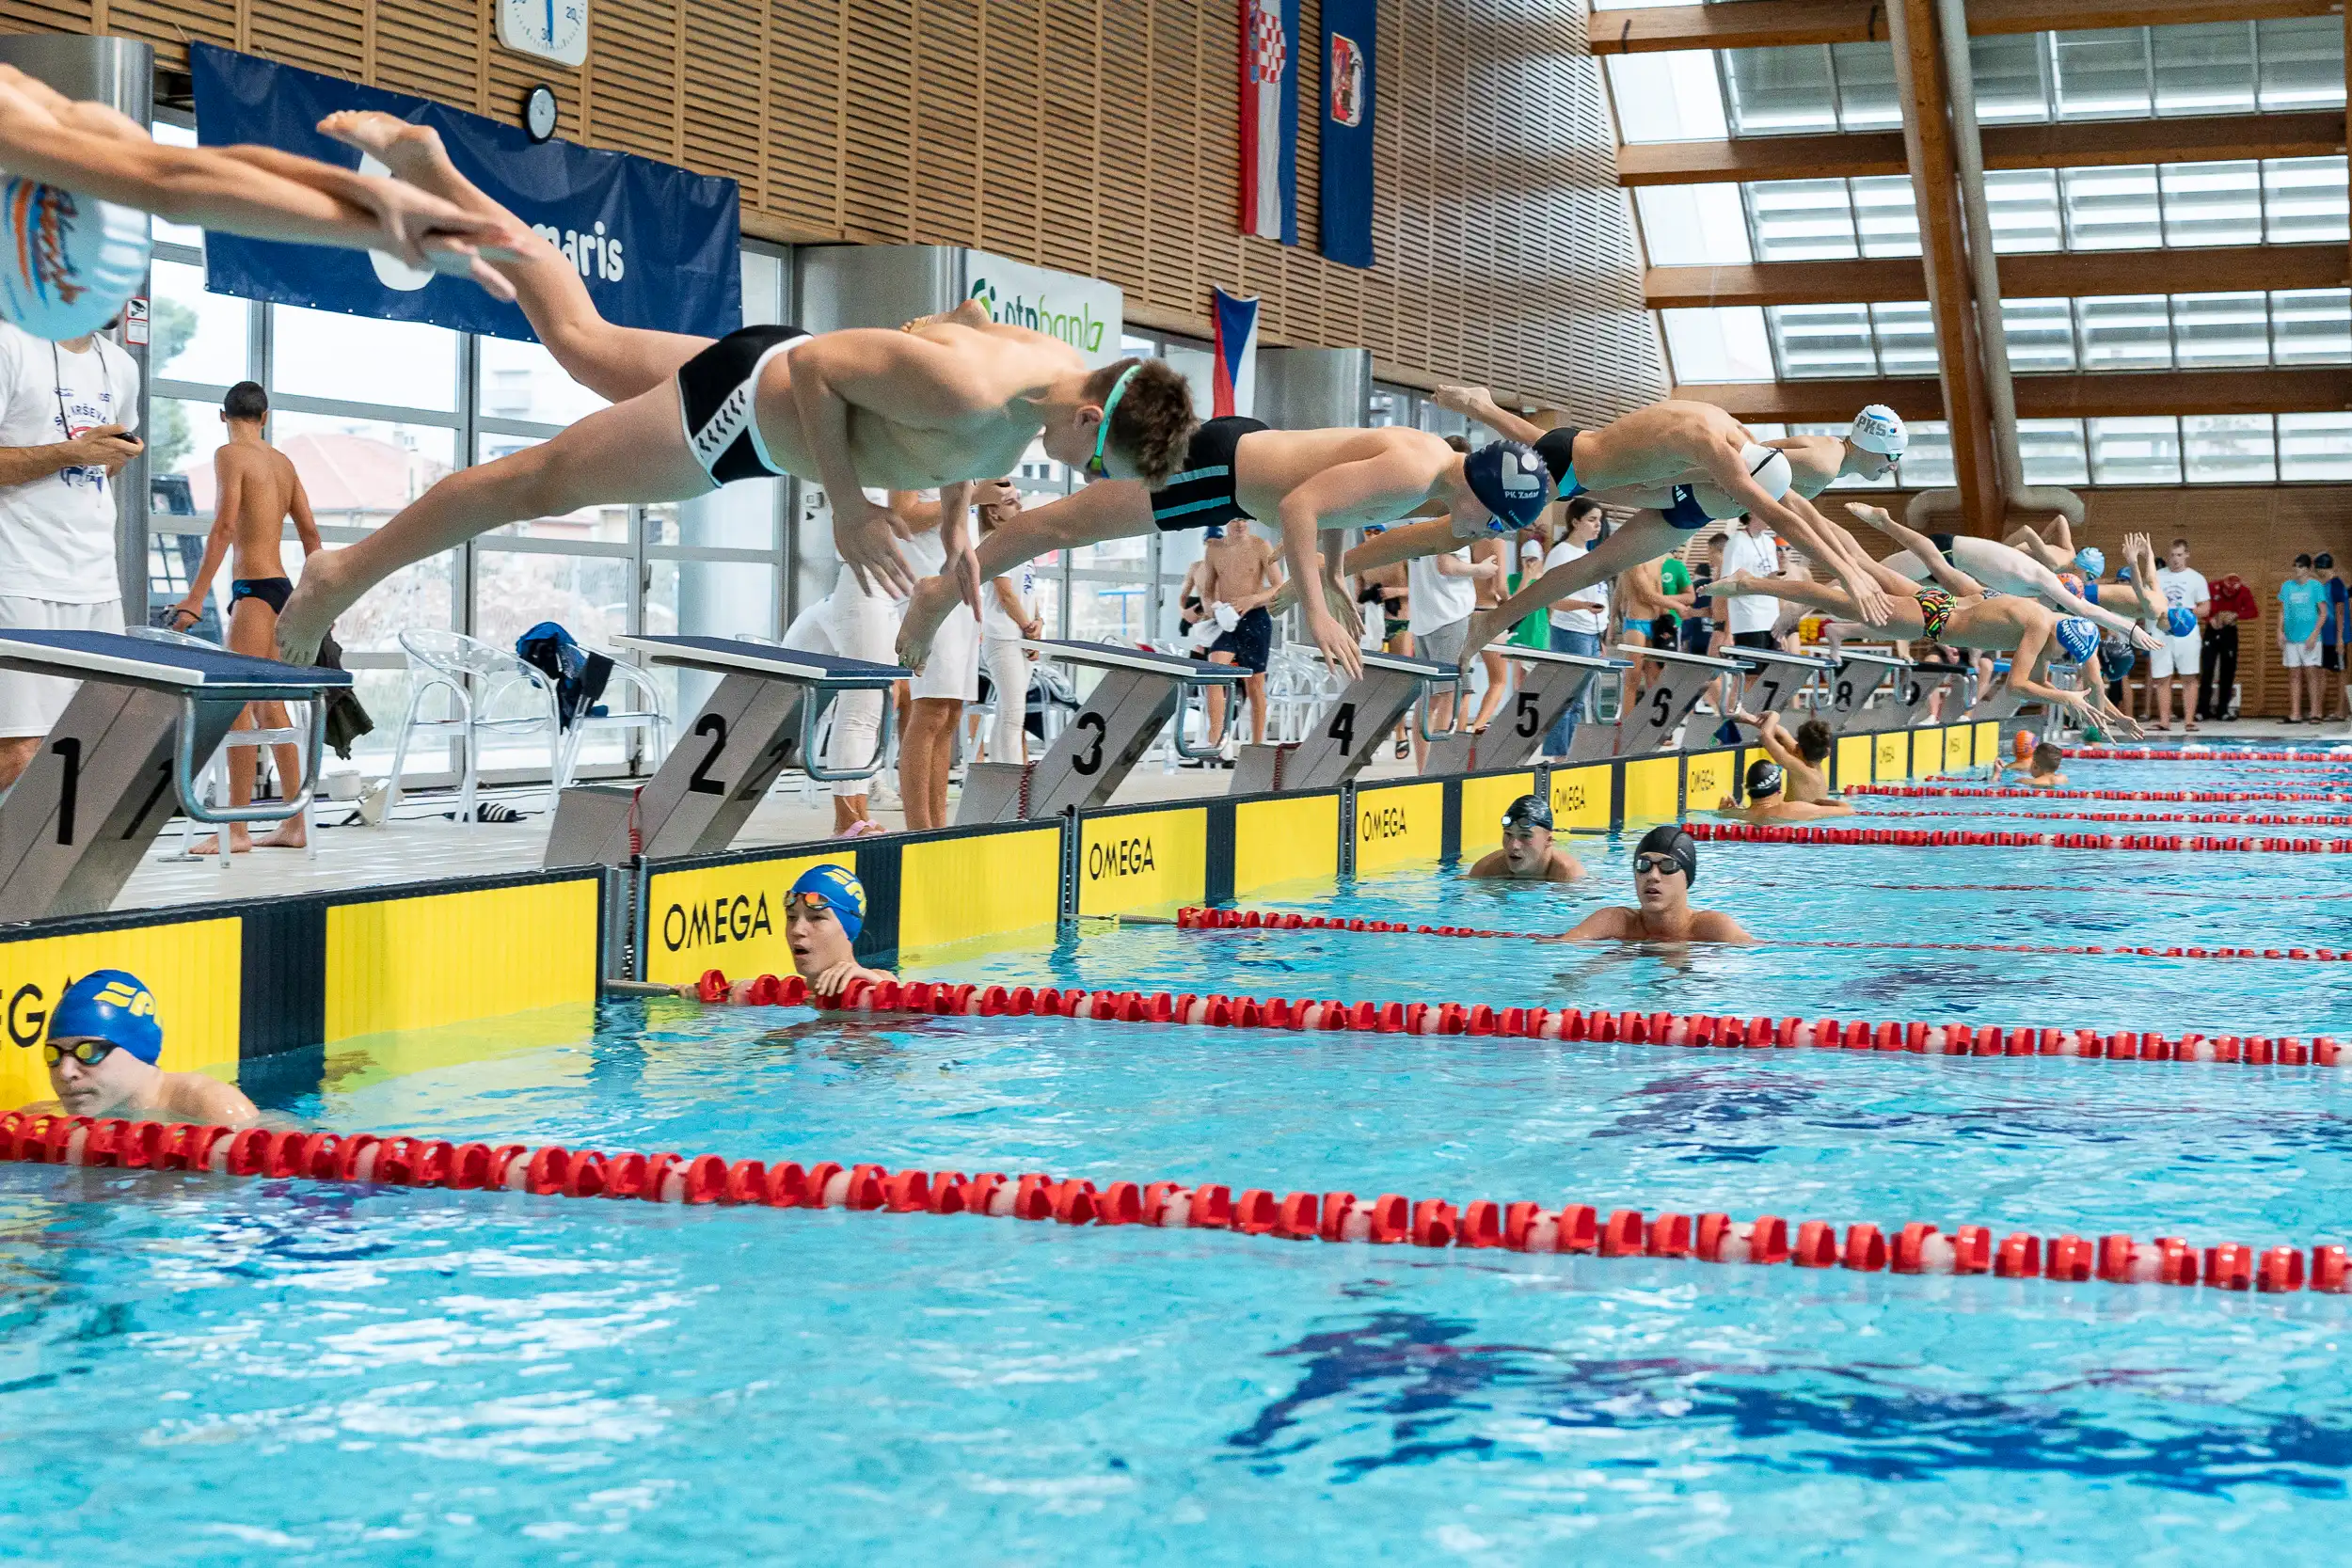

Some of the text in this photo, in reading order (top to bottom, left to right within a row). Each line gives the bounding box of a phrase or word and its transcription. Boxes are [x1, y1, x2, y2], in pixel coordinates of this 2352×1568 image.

[1855, 415, 1887, 437] PKS
[1504, 490, 1540, 499] PK Zadar
[1516, 691, 1540, 738] 5
[1762, 679, 1780, 712] 7
[1836, 680, 1852, 712] 8
[1073, 711, 1105, 776] 3
[1327, 702, 1356, 756] 4
[689, 713, 726, 797] 2
[735, 737, 792, 801] 2
[52, 736, 81, 846] 1
[1554, 784, 1586, 814] OMEGA
[1362, 806, 1407, 842] OMEGA
[1089, 835, 1155, 880] OMEGA
[664, 889, 772, 952] OMEGA
